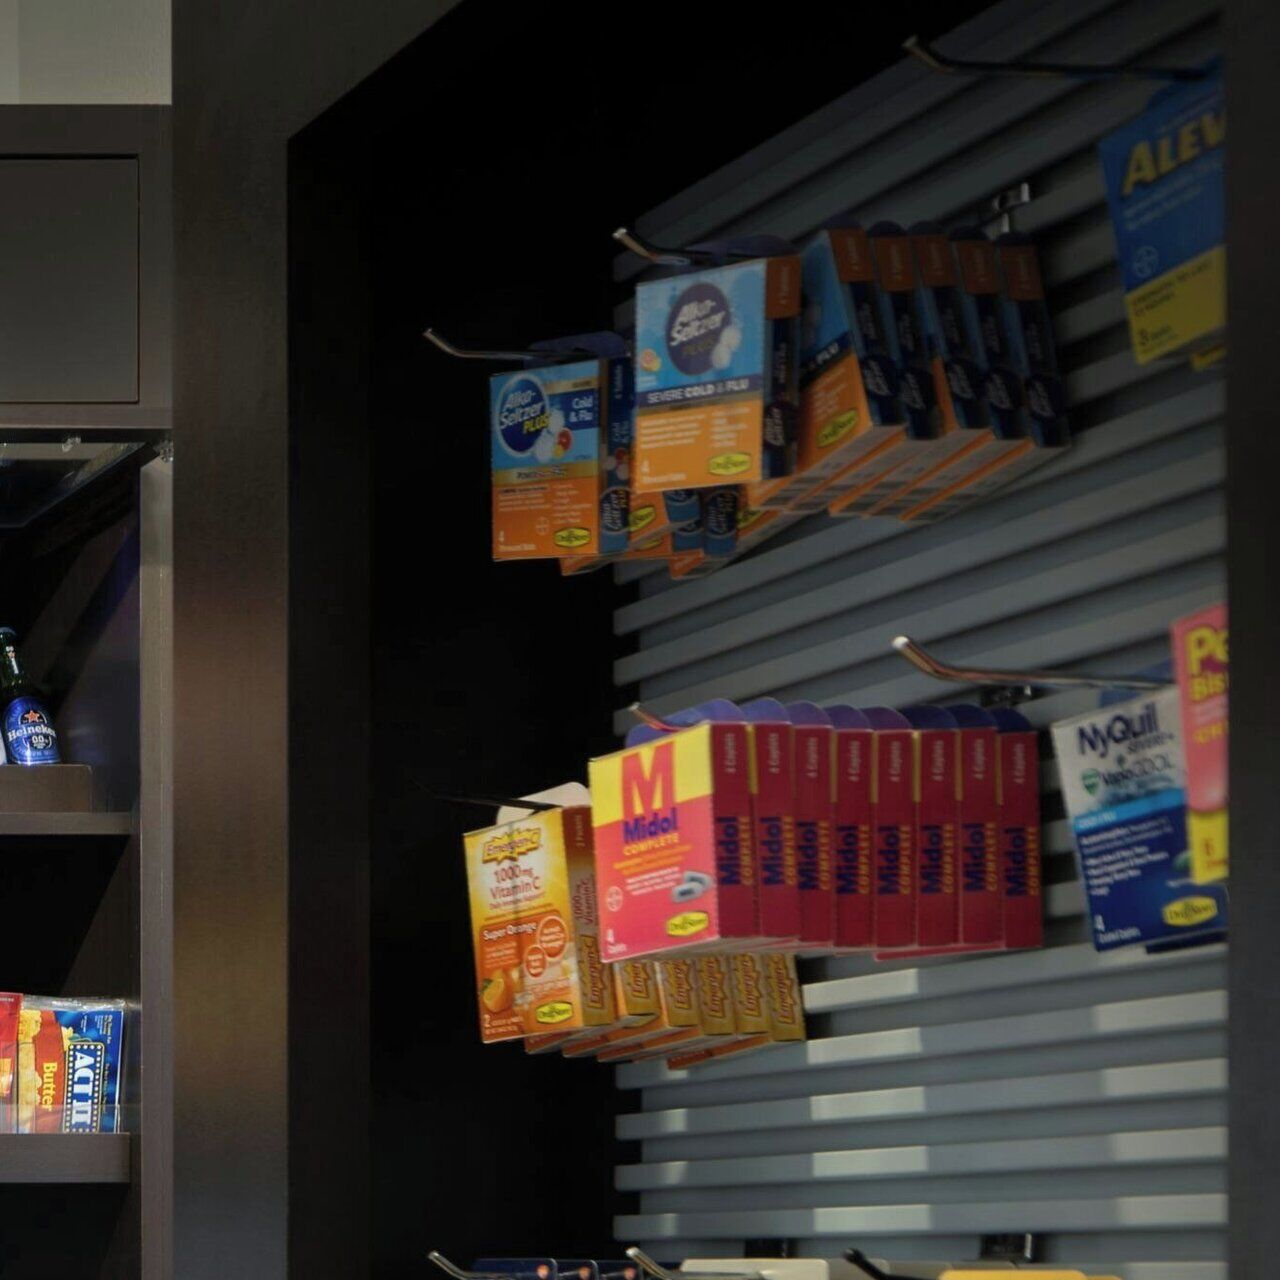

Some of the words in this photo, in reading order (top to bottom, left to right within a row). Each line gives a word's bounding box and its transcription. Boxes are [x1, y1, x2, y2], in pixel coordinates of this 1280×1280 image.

[572, 396, 594, 410] Cold
[647, 389, 684, 404] SEVERE
[684, 384, 716, 398] COLD
[725, 378, 750, 391] FLU
[500, 402, 545, 427] Seltzer
[523, 413, 550, 434] PLUS
[1078, 703, 1161, 758] NyQuil
[621, 741, 675, 822] M
[623, 808, 679, 843] Midol
[717, 817, 740, 886] Midol
[760, 816, 783, 885] Midol
[483, 927, 507, 941] Super
[41, 1062, 58, 1112] Butter
[73, 1051, 95, 1096] ACT
